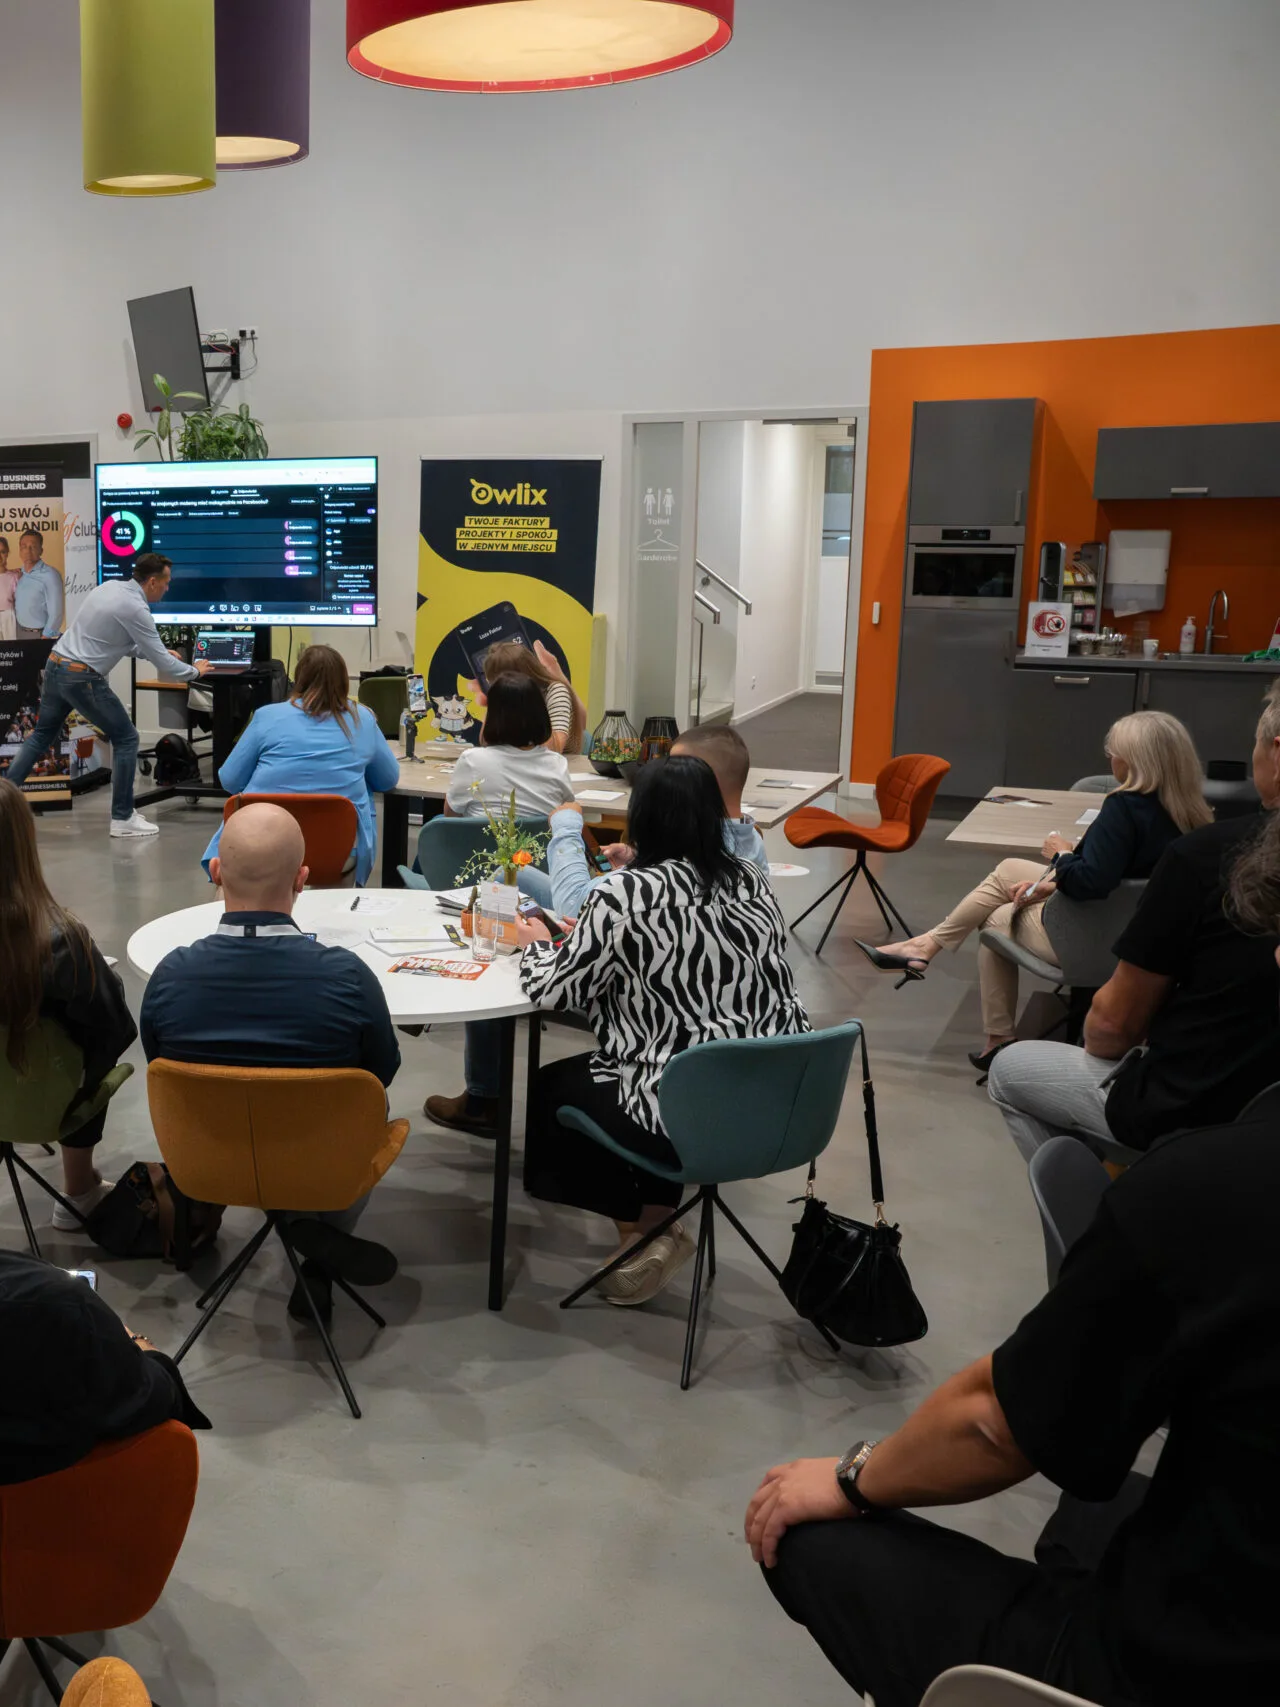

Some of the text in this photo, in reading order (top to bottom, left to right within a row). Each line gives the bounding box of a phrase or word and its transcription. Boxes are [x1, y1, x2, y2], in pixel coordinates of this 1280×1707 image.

[3, 474, 46, 482] BUSINESS
[470, 478, 548, 505] Owlix
[9, 504, 50, 519] SWÓJ
[468, 517, 546, 526] TWOJE FAKTURY
[458, 530, 507, 538] PROJEKTY
[515, 528, 553, 539] SPOKÓJ
[512, 543, 553, 552] MIEJSCU
[2, 684, 19, 692] całej
